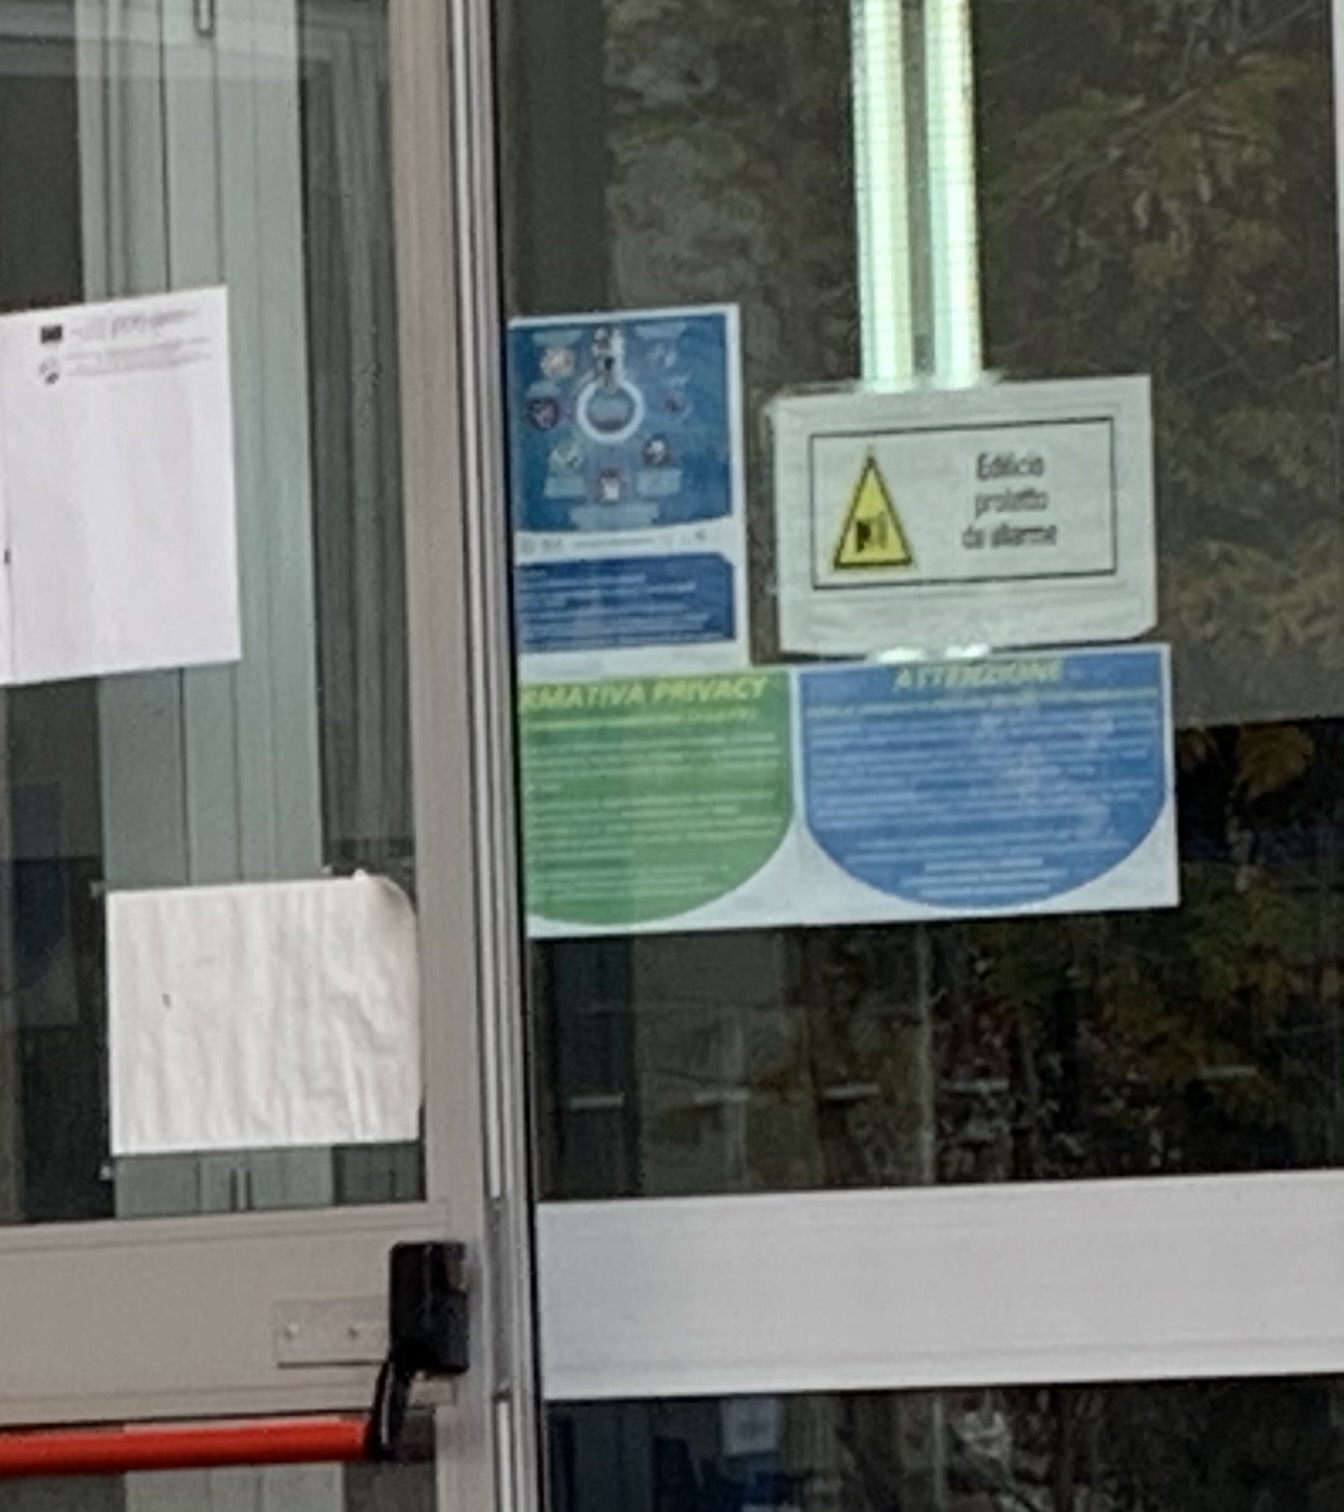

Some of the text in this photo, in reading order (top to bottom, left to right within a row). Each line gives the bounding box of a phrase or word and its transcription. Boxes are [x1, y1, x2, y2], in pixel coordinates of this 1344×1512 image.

[976, 451, 1044, 481] Edificio
[974, 487, 1049, 520] protetto
[991, 521, 1058, 549] allarme
[652, 676, 768, 705] PRIVACY
